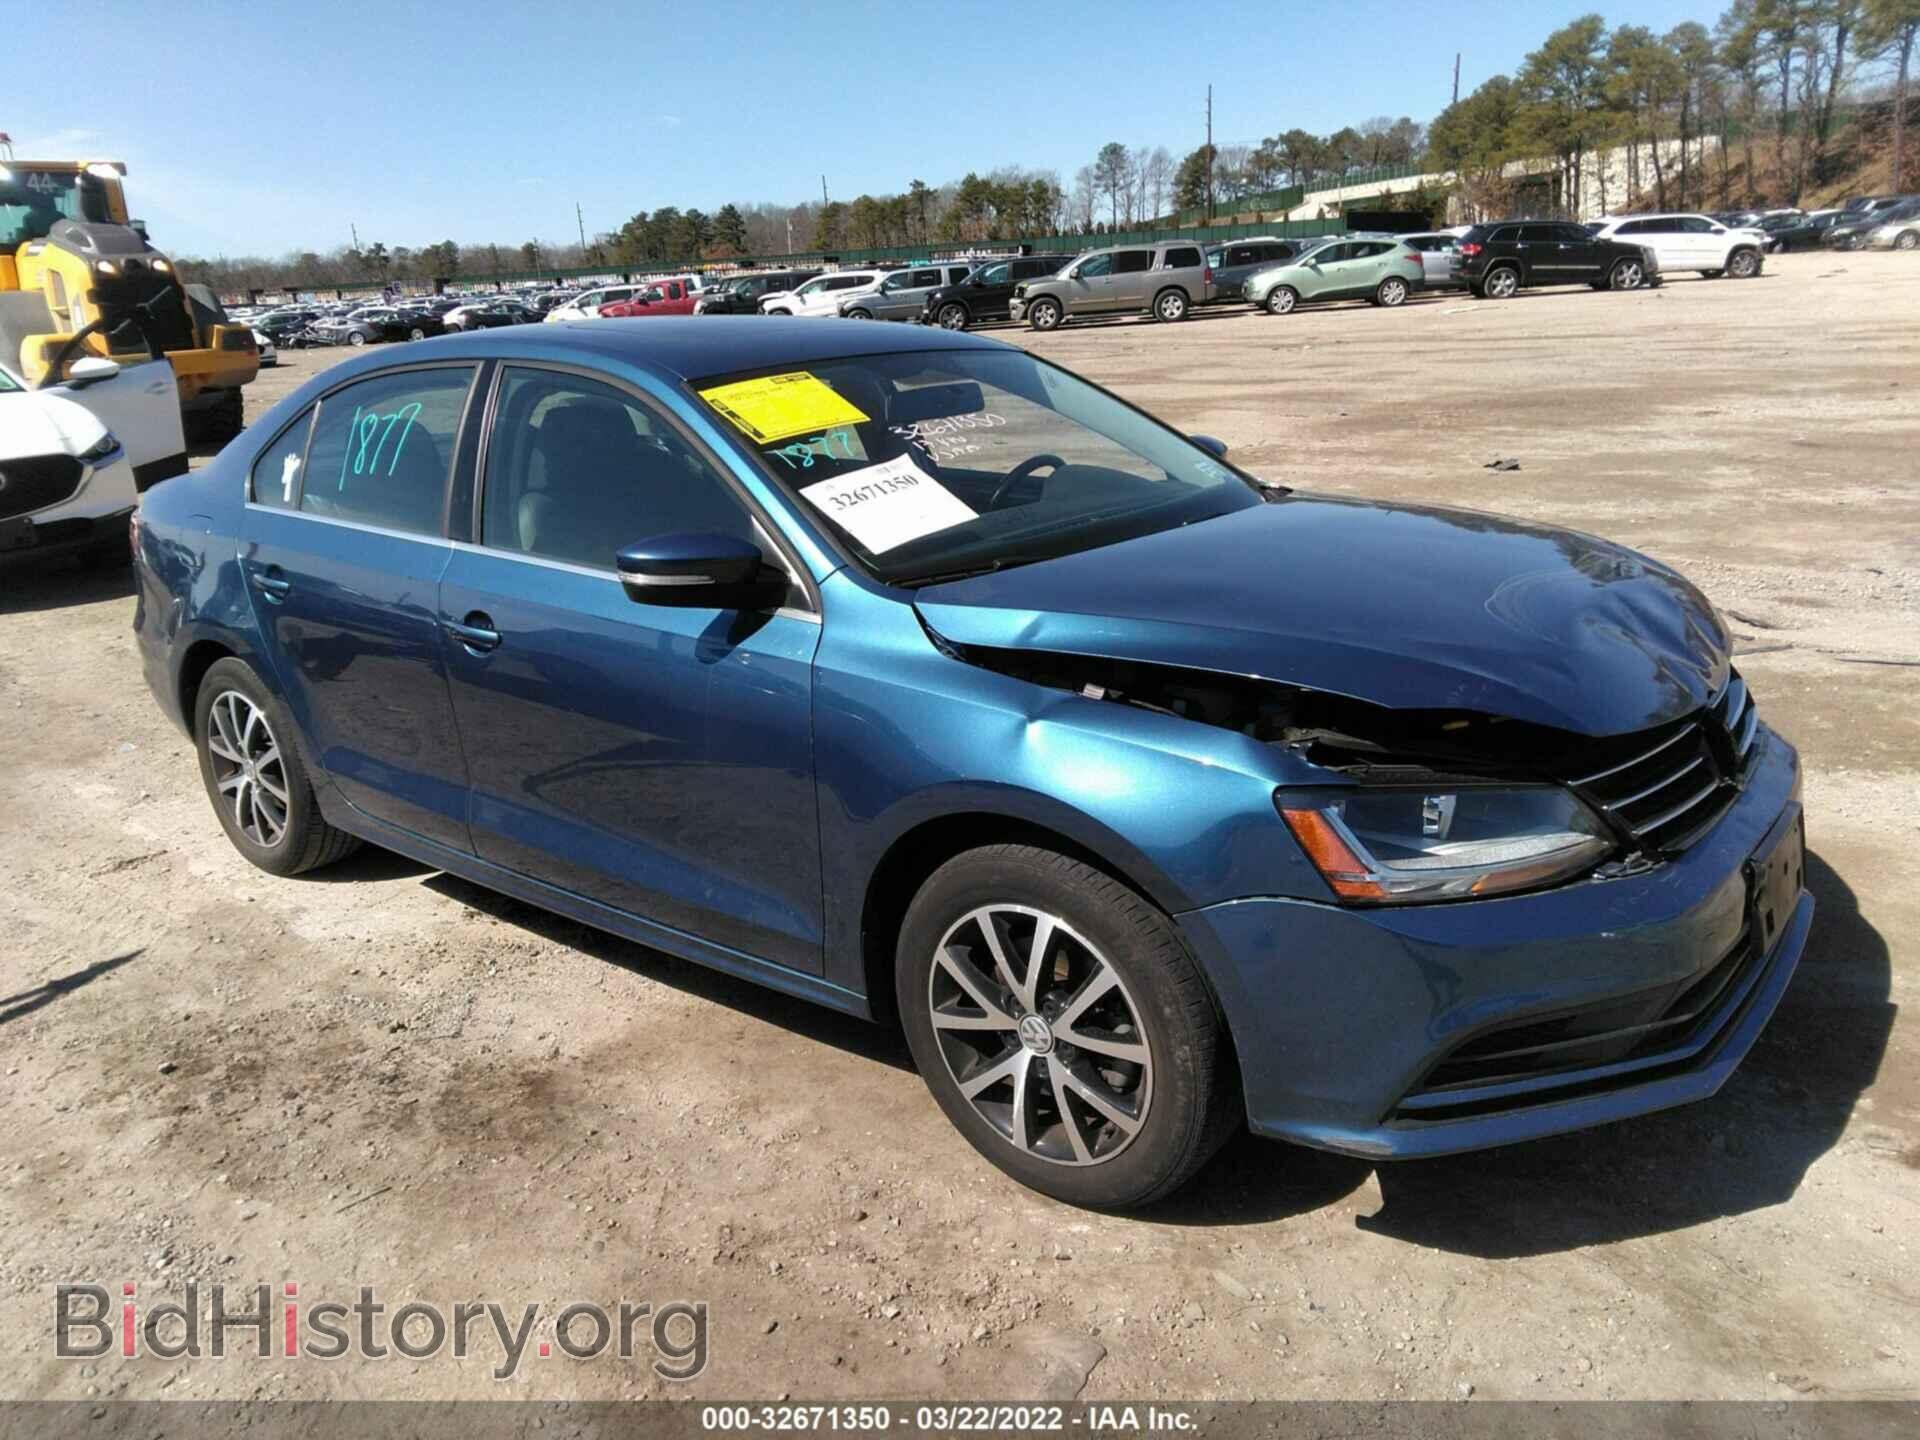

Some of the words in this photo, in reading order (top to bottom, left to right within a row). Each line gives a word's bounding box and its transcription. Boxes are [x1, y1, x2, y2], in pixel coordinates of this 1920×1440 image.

[338, 402, 422, 492] 1877
[774, 431, 855, 469] 1877
[829, 474, 919, 511] 32671350
